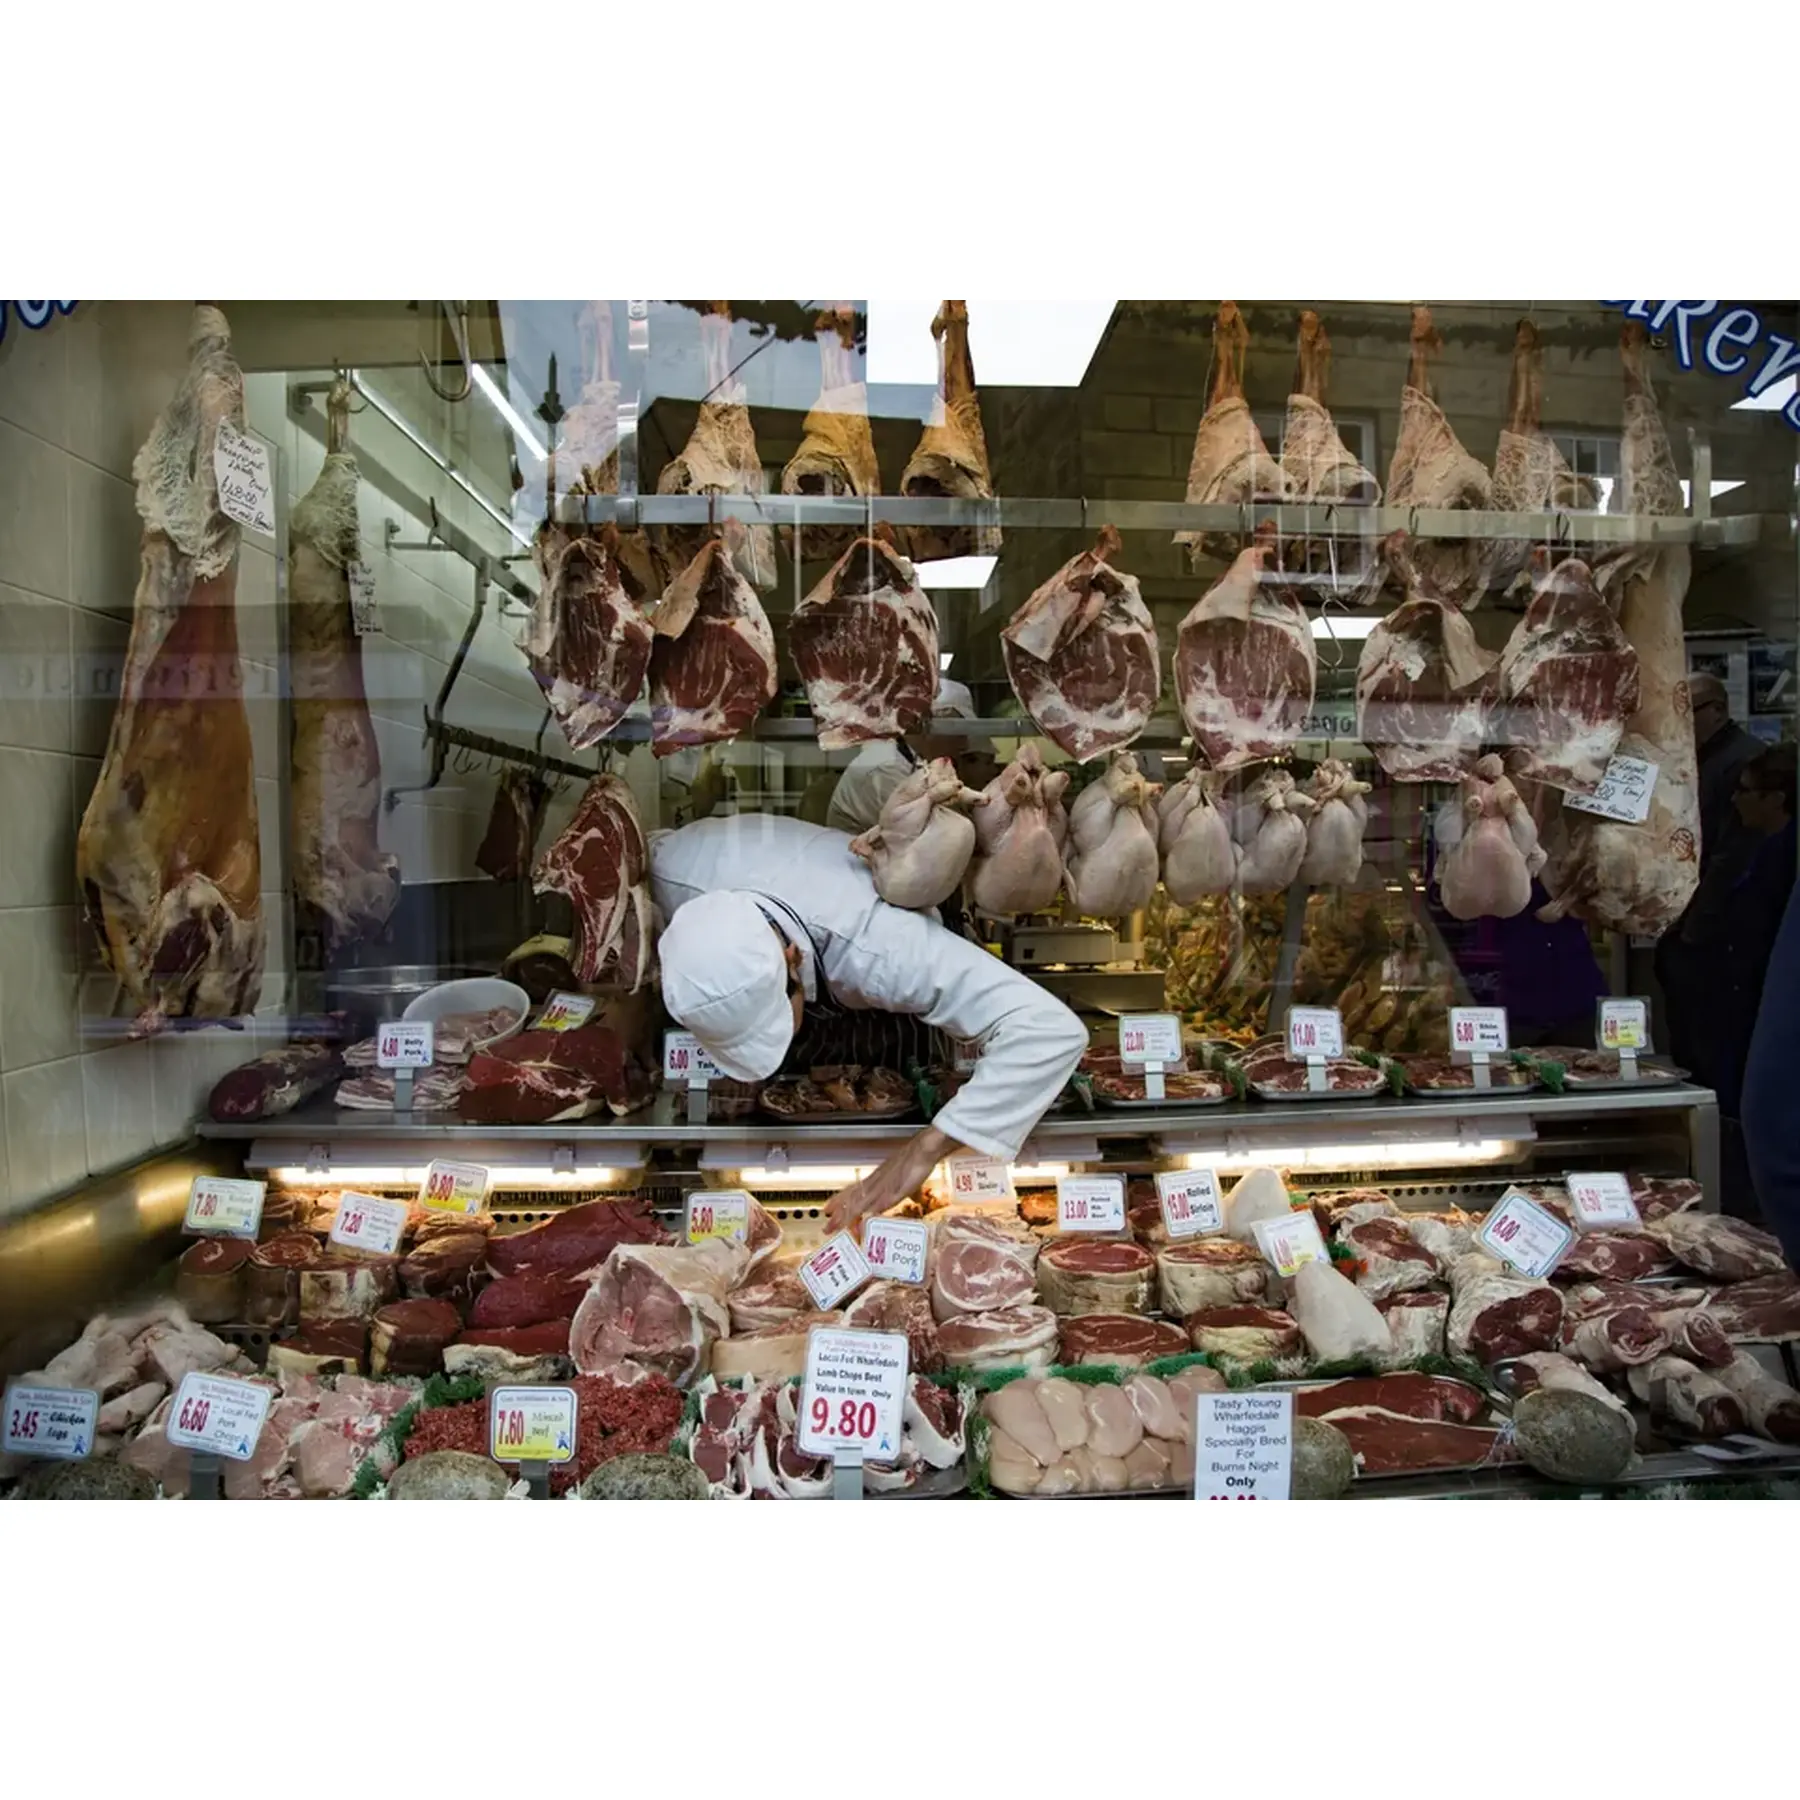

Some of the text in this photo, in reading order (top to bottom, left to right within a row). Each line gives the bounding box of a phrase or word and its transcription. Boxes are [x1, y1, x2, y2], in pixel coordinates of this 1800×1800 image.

[893, 1239, 922, 1253] Crop
[839, 1369, 863, 1382] Chops
[864, 1372, 882, 1382] Best
[815, 1383, 836, 1394] Value
[847, 1386, 866, 1396] town
[872, 1390, 892, 1400] Only
[1213, 1398, 1282, 1410] Tasty Young
[49, 1411, 86, 1425] Chicken
[811, 1397, 877, 1439] 9.80
[1213, 1411, 1280, 1421] Wharfedale
[10, 1409, 40, 1439] 3.45
[217, 1418, 237, 1429] Pork
[498, 1410, 524, 1445] 7.60
[1226, 1424, 1267, 1435] Haggis
[1204, 1436, 1287, 1448] Specially Bred
[1235, 1449, 1255, 1459] For
[1211, 1460, 1279, 1473] Burns Night
[1225, 1476, 1256, 1488] Only
